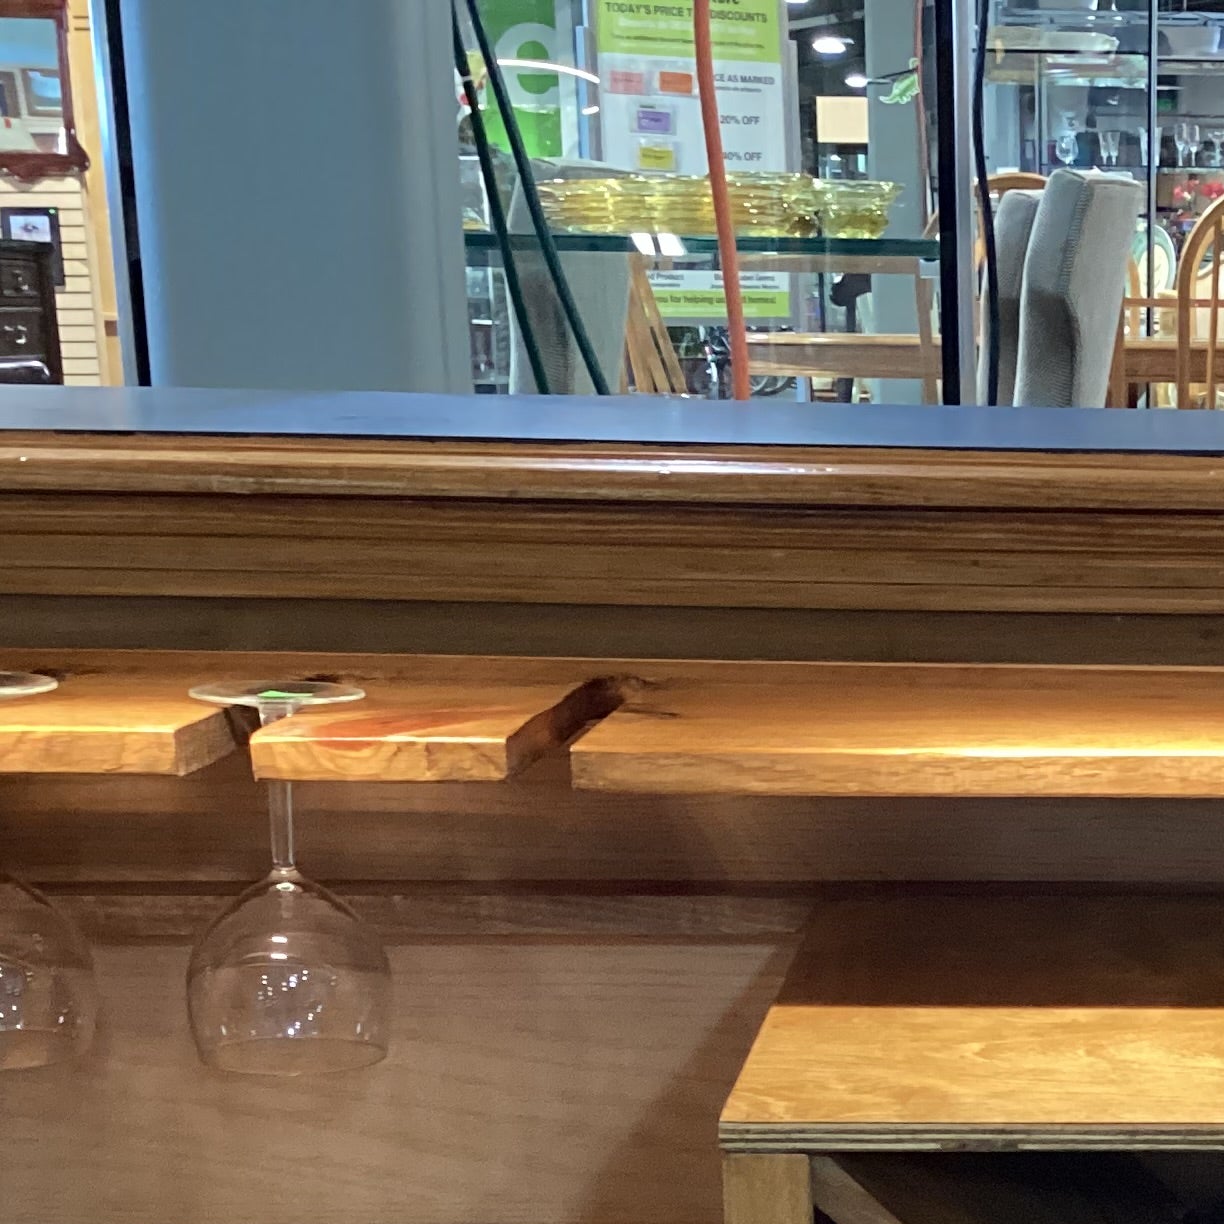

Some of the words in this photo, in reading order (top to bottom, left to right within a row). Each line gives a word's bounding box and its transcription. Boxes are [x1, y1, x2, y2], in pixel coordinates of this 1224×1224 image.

[605, 2, 651, 14] TODAY'S
[653, 6, 684, 17] PRICE
[710, 9, 768, 23] DISCOUNTS
[740, 75, 776, 85] MARKED
[742, 115, 761, 125] OFF
[744, 152, 763, 161] OFF
